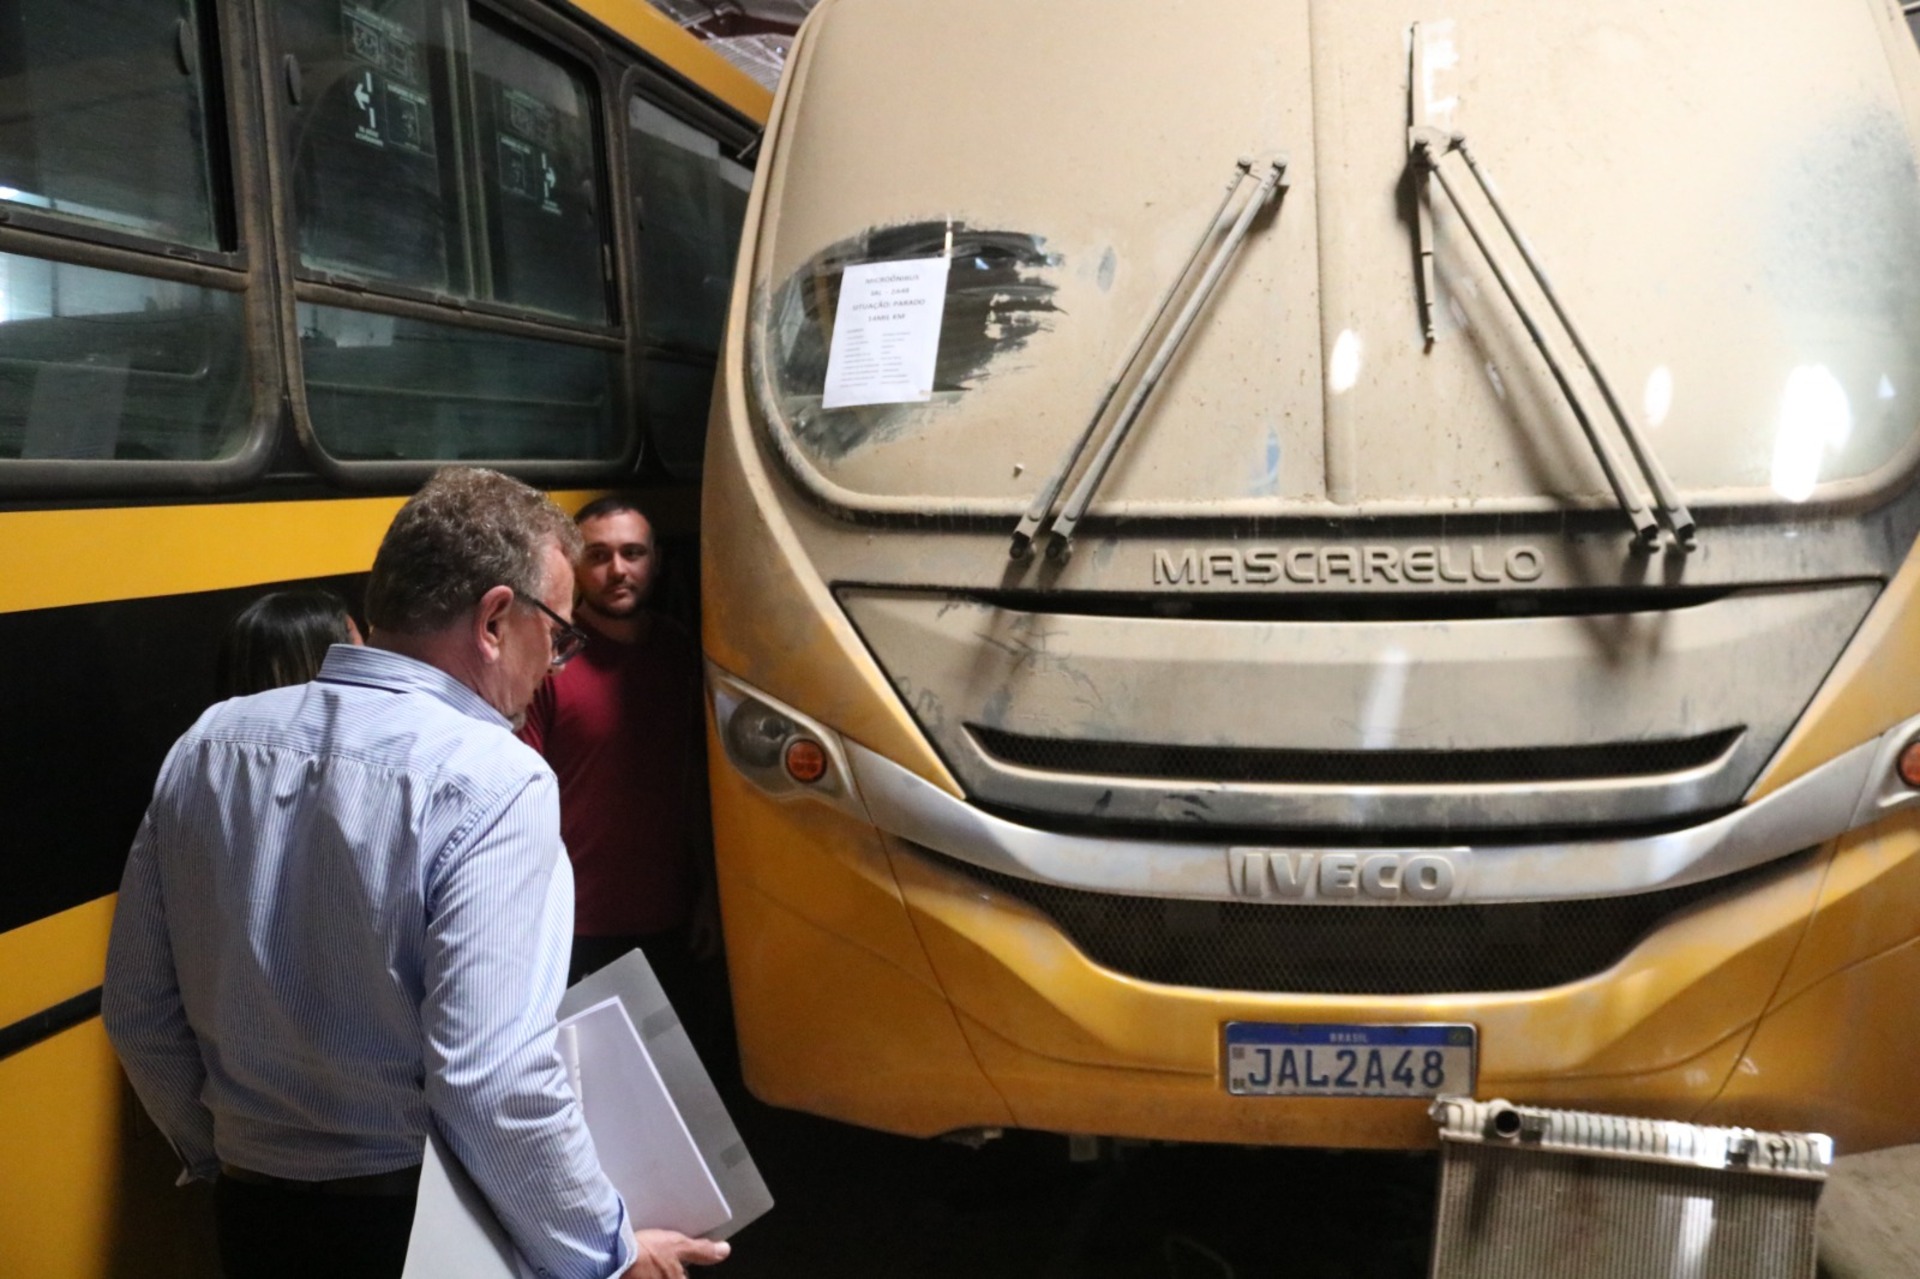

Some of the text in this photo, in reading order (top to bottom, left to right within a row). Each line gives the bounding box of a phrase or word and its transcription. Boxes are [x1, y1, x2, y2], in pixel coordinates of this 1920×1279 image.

[893, 298, 925, 306] PARADO
[1153, 545, 1545, 584] MASCARELLO
[1240, 852, 1455, 901] IVECO
[1329, 1032, 1368, 1043] BRASIL
[1248, 1048, 1444, 1089] JAL2A48
